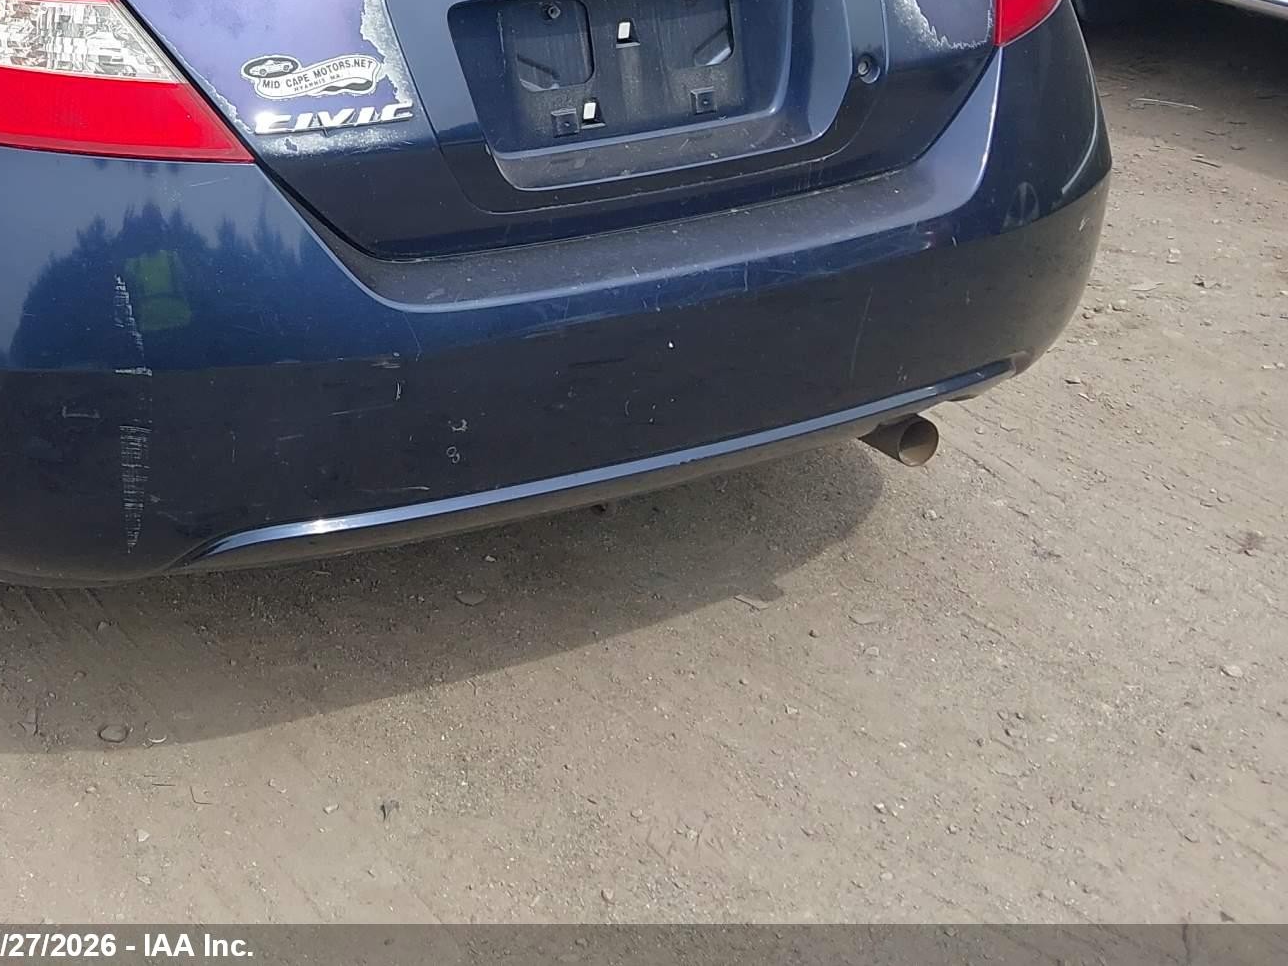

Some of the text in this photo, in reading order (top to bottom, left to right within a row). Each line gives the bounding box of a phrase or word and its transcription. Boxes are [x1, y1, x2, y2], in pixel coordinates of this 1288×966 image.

[262, 59, 373, 90] MID CAPE MOTORS.NET
[294, 77, 326, 92] HYANNIS
[254, 102, 413, 134] CIVIC
